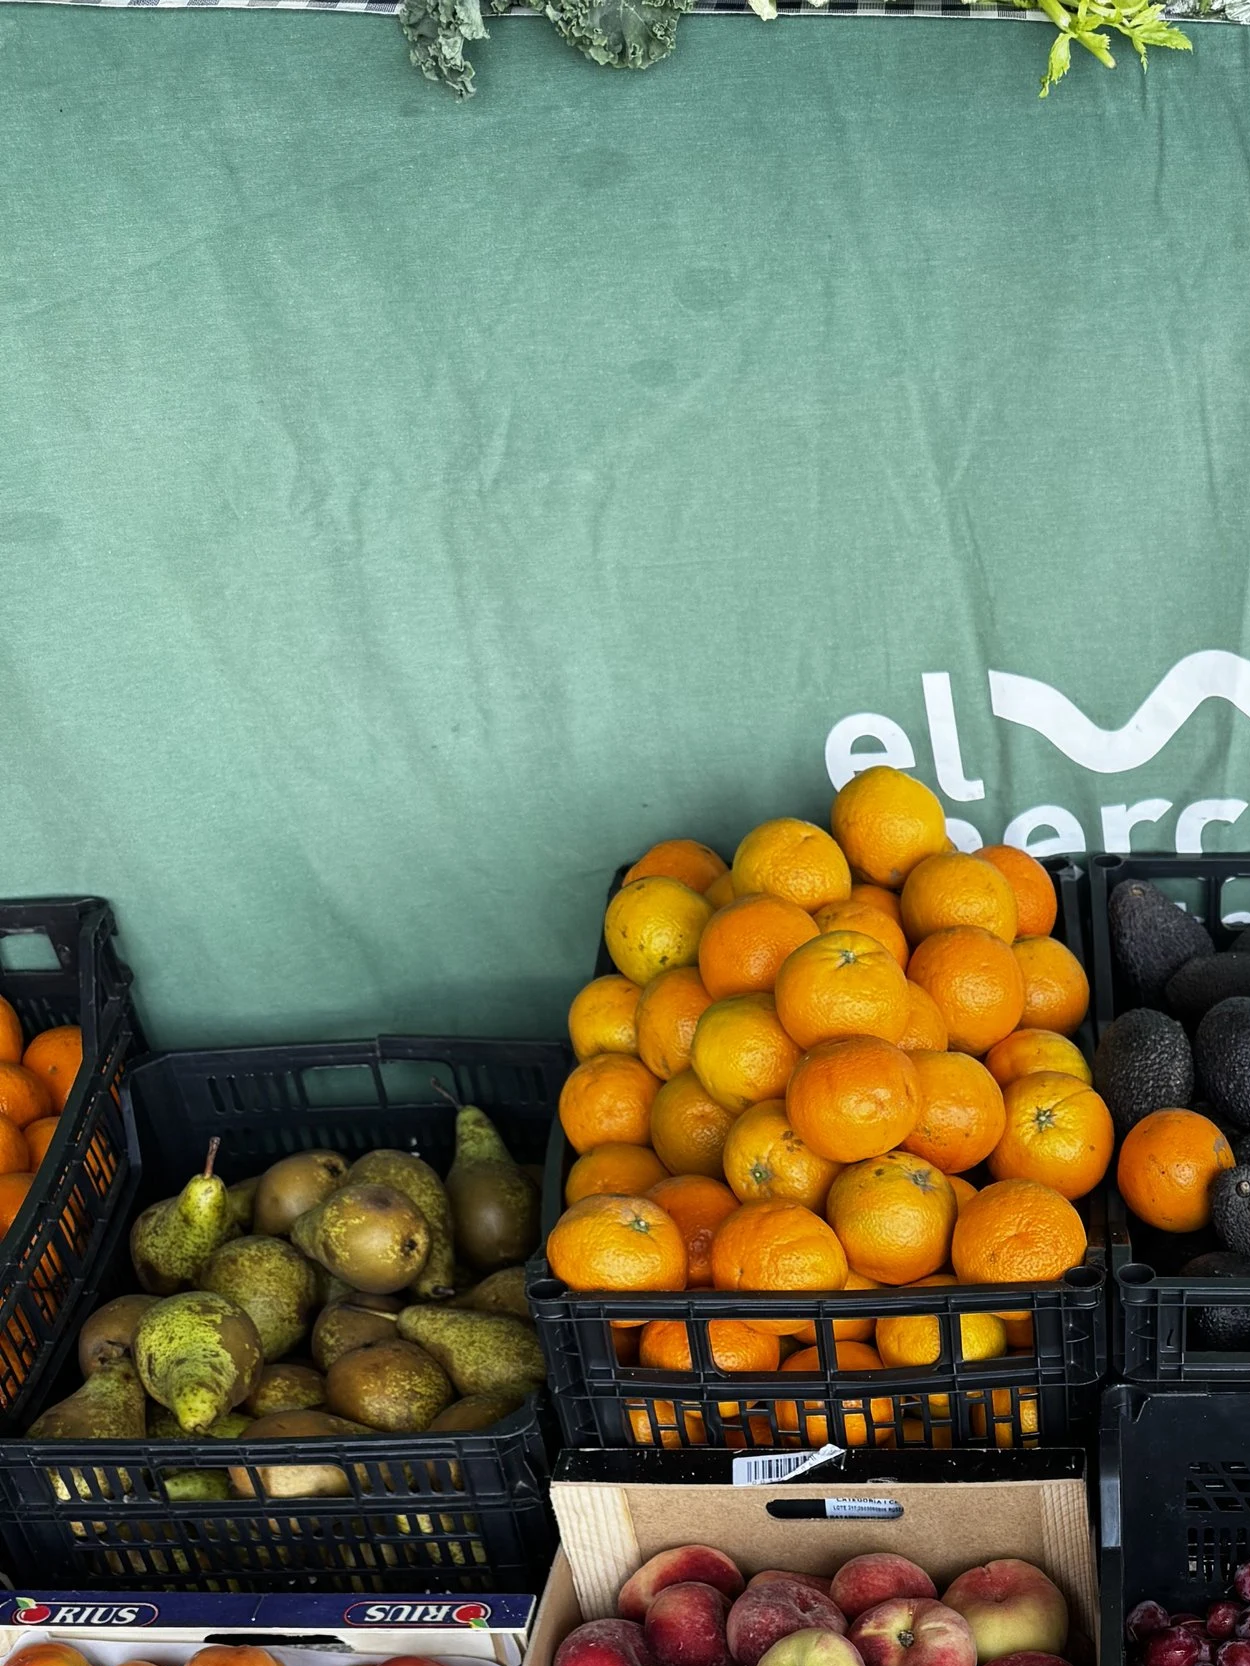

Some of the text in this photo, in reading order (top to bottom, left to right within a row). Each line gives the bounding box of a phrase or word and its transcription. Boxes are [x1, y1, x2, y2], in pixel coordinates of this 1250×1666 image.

[825, 671, 986, 802] el
[50, 1605, 141, 1625] RIUS
[364, 1603, 452, 1623] RIUS
